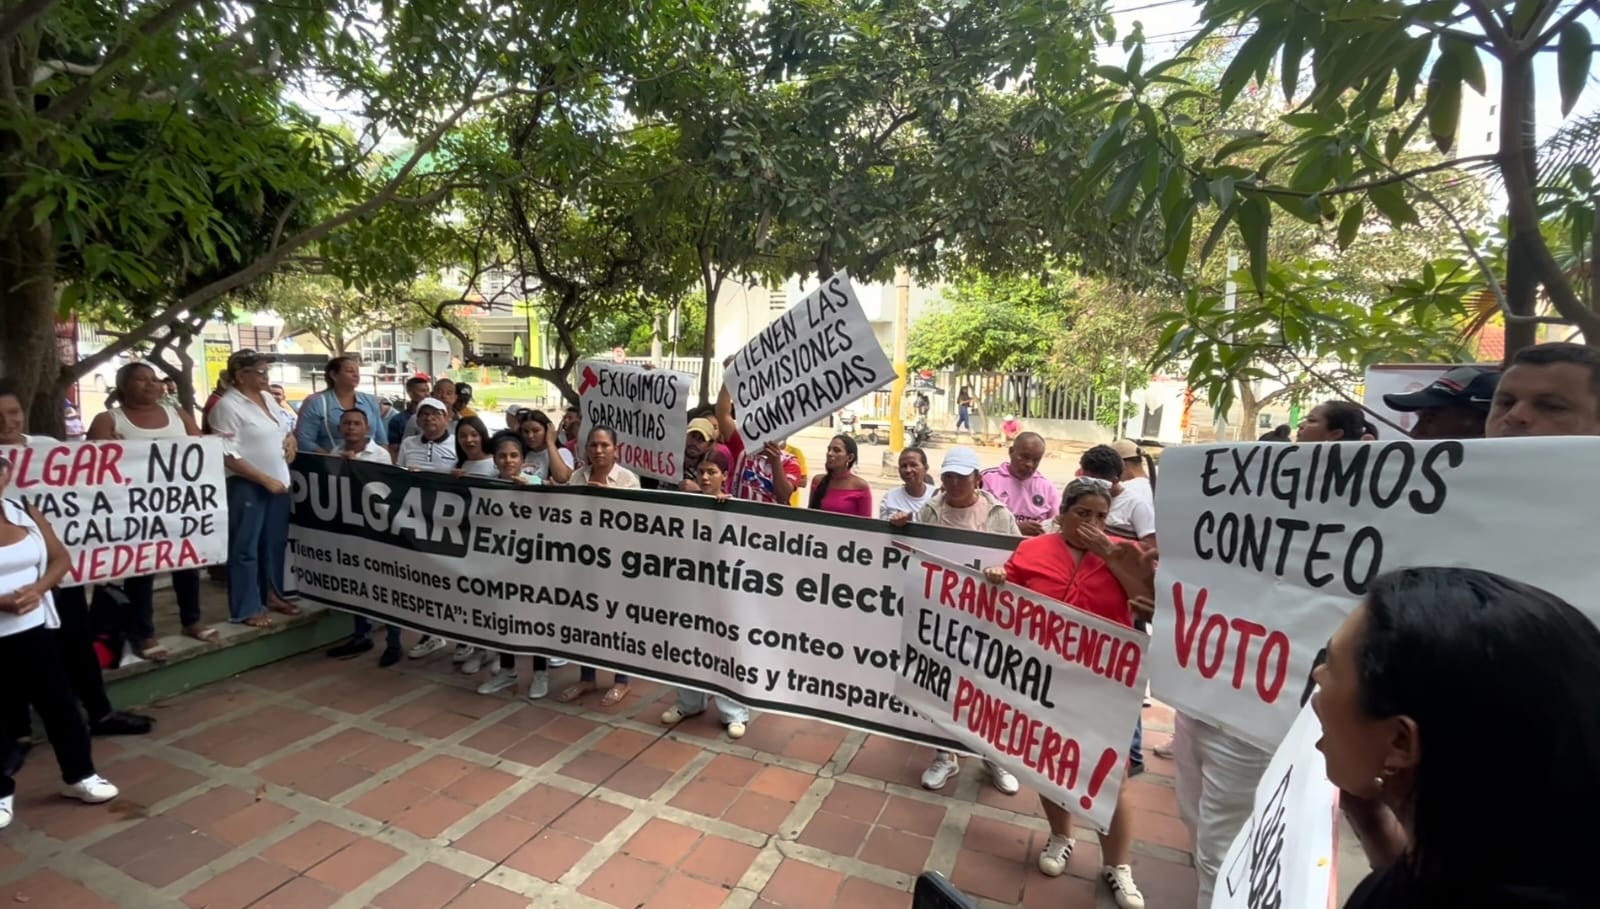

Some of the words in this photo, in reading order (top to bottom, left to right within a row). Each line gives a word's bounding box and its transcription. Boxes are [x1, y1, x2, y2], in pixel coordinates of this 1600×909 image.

[734, 309, 797, 377] TIENEN
[806, 277, 849, 329] LAS
[737, 319, 853, 408] COMISIONES
[588, 400, 665, 441] GARANTIAS
[599, 369, 678, 409] EXIGIMOS
[742, 354, 877, 441] COMPRADAS
[147, 443, 204, 483] NO
[615, 442, 676, 477] TORALES
[1200, 440, 1465, 515] EXIGIMOS
[63, 515, 168, 546] CALDIA
[180, 513, 215, 539] DE
[92, 491, 113, 515] A
[128, 484, 218, 514] ROBAR
[290, 469, 466, 545] PULGAR
[475, 497, 504, 517] No
[509, 501, 533, 519] te
[538, 505, 573, 524] vas
[579, 510, 593, 526] a
[599, 508, 685, 539] ROBAR
[692, 518, 713, 542] la
[718, 524, 829, 560] Alcaldía
[836, 540, 874, 566] de
[68, 538, 209, 583] NEDERA.
[473, 526, 612, 569] Exigimos
[621, 549, 784, 597] garantías
[1193, 510, 1384, 596] CONTEO
[287, 538, 332, 563] Tienes
[336, 547, 360, 567] las
[363, 557, 451, 590] comisiones
[457, 575, 599, 612] COMPRADAS
[605, 599, 619, 619] y
[625, 602, 740, 641] queremos
[747, 627, 844, 660] conteo
[853, 645, 901, 672] vot
[372, 584, 388, 604] SE
[472, 609, 555, 637] Exigimos
[560, 624, 647, 657] garantías
[651, 639, 759, 685] electorales
[764, 669, 780, 692] y
[920, 561, 1142, 688] TRANSPARENCIA
[1172, 580, 1290, 705] VOTO
[902, 643, 952, 702] PARA
[917, 608, 1056, 709] ELECTORAL
